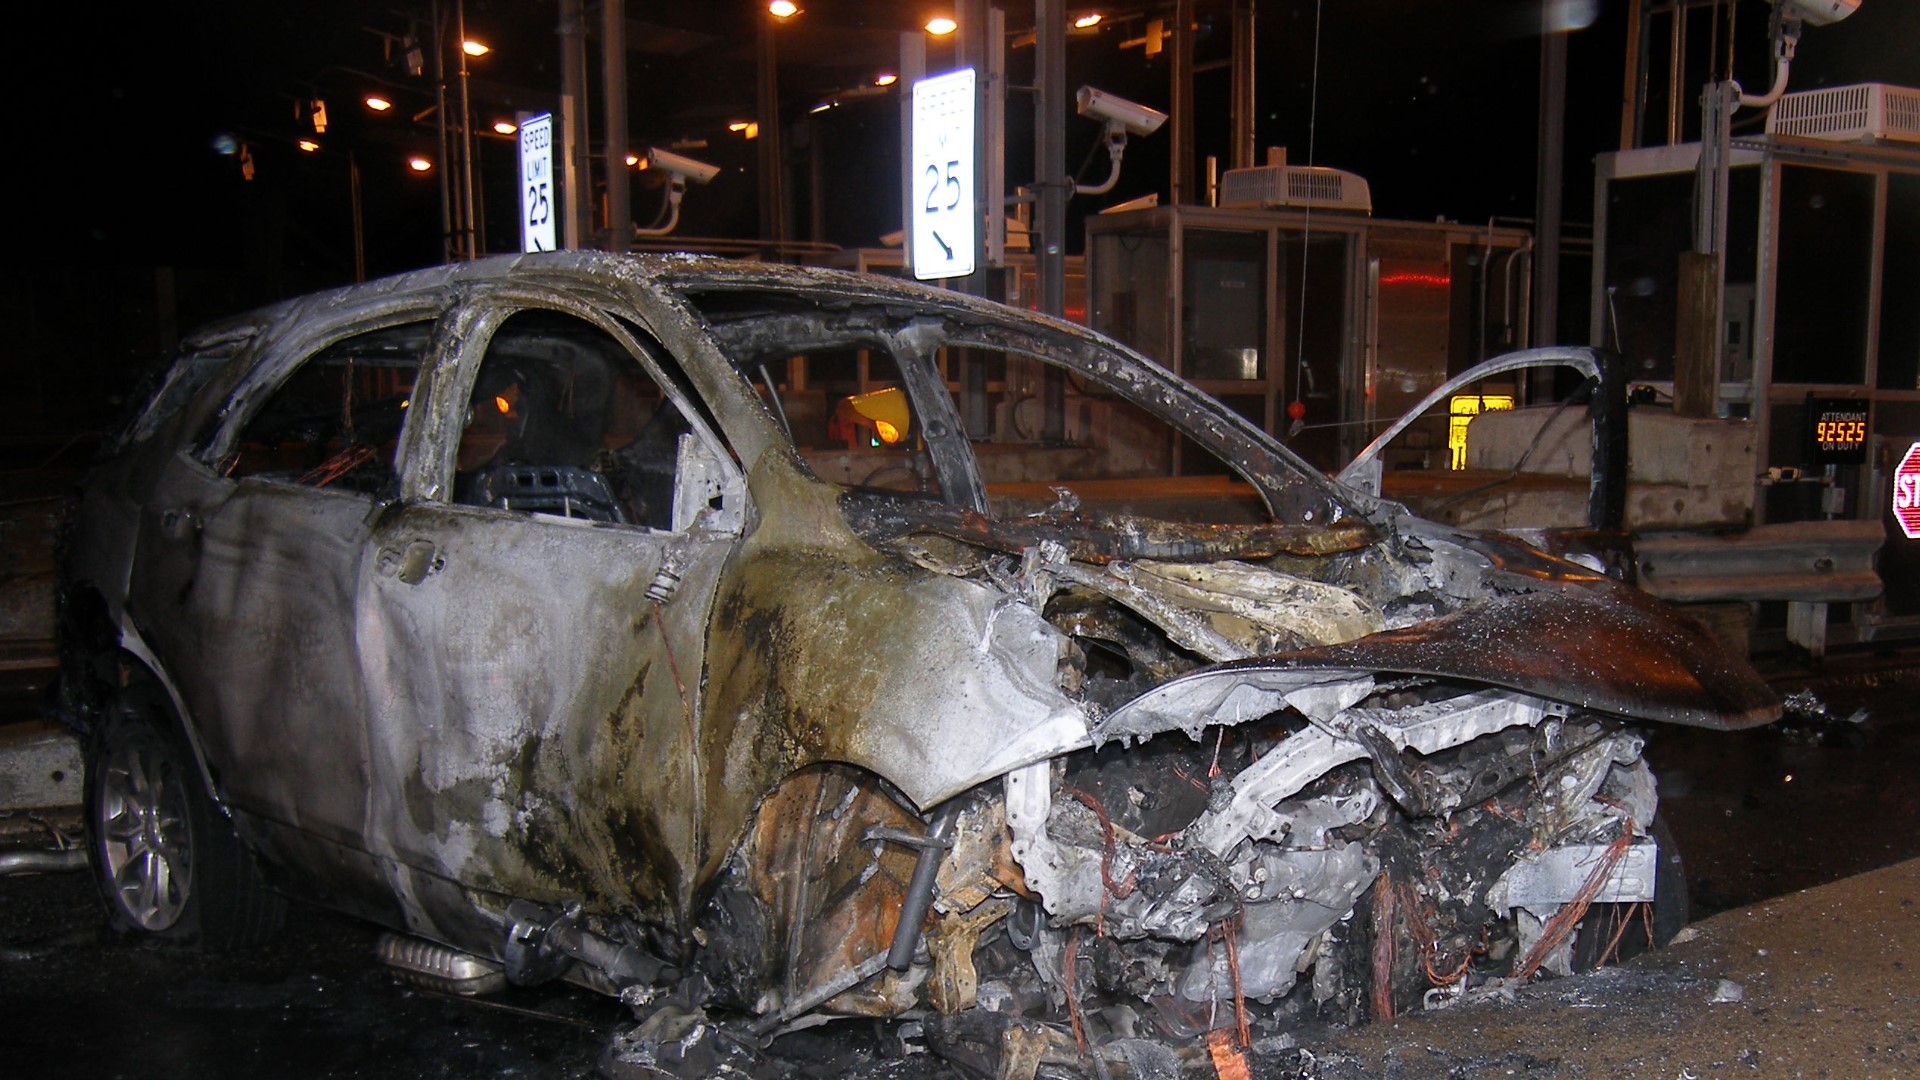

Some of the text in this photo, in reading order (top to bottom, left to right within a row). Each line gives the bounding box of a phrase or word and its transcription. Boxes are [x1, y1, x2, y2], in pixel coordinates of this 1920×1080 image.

[523, 126, 549, 153] SPEED
[527, 157, 547, 181] LIMIT
[925, 160, 961, 213] 25
[529, 183, 549, 227] 25
[1821, 412, 1867, 422] ATTENDANT
[1817, 422, 1865, 442] 92525
[1822, 441, 1860, 451] ON DUTY
